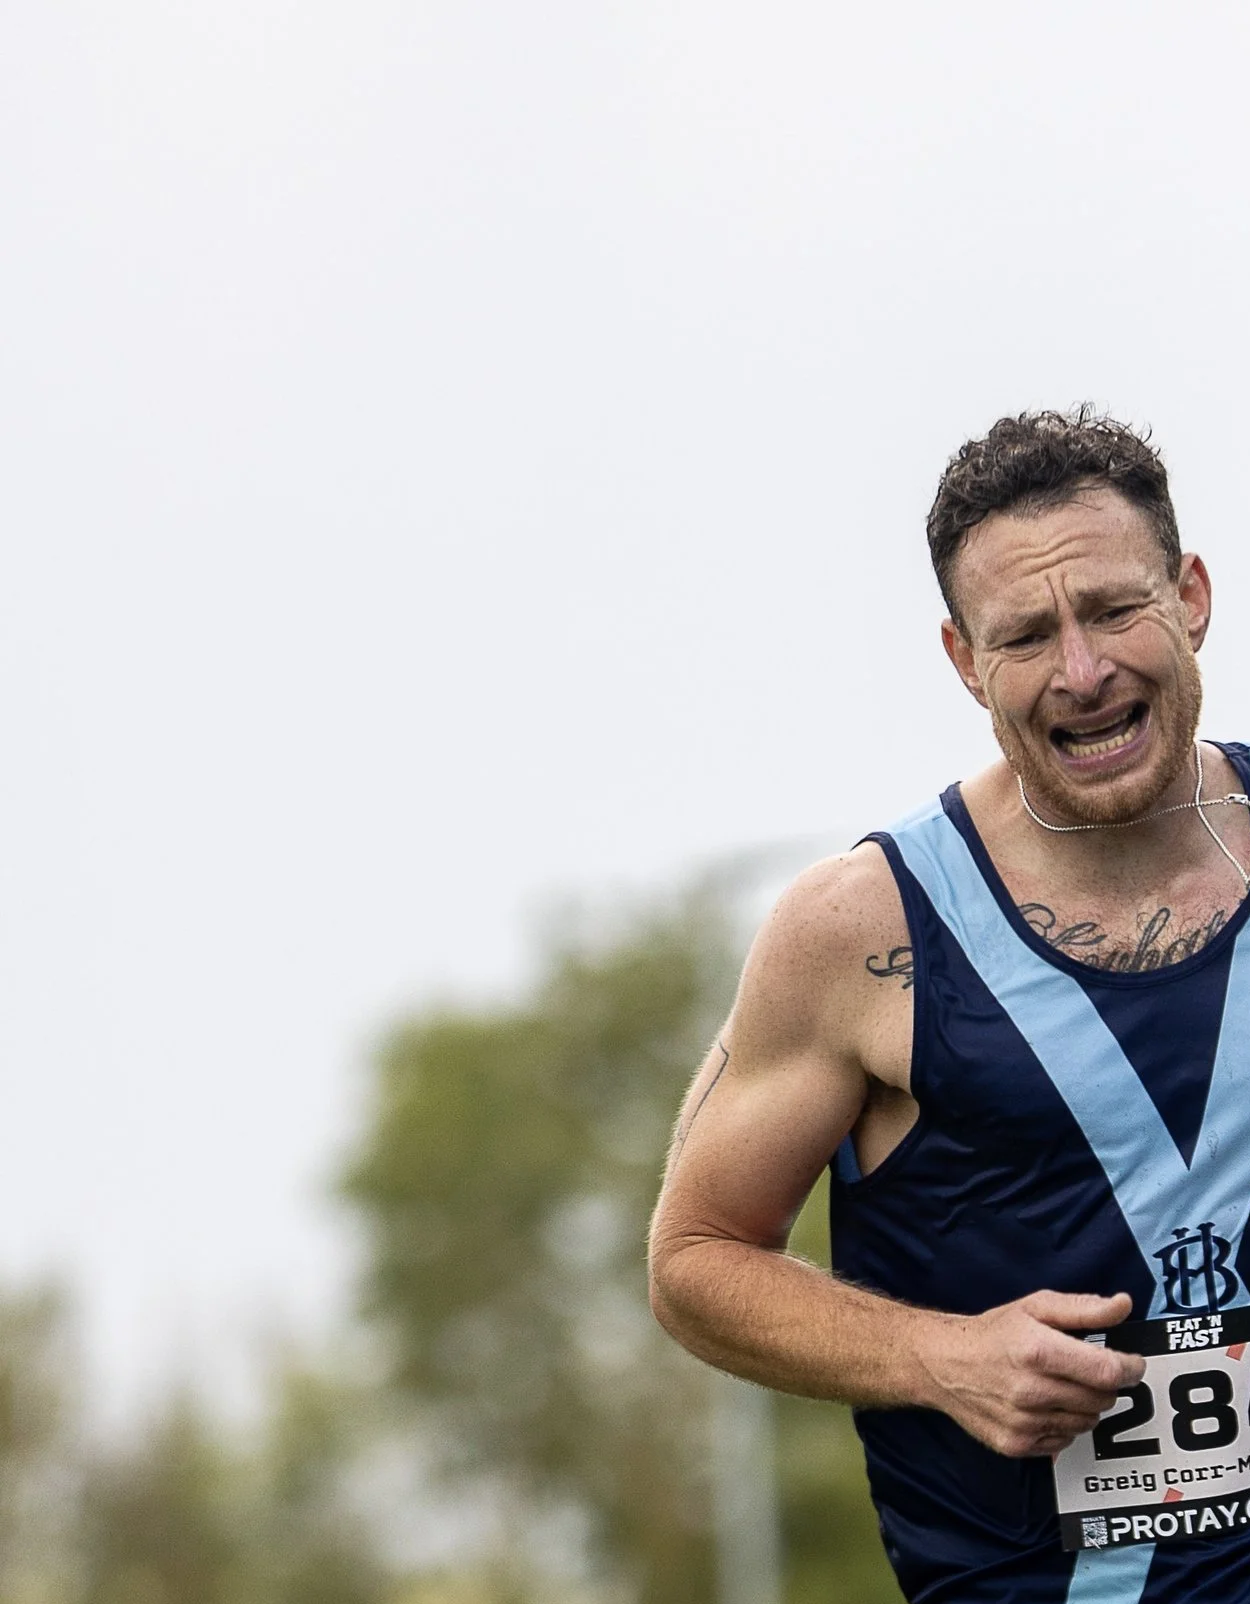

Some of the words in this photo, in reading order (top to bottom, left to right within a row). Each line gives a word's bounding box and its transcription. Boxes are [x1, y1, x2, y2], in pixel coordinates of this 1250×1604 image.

[1166, 1317, 1202, 1333] FLAT
[1169, 1327, 1224, 1350] FAST
[1084, 1469, 1157, 1493] Greig
